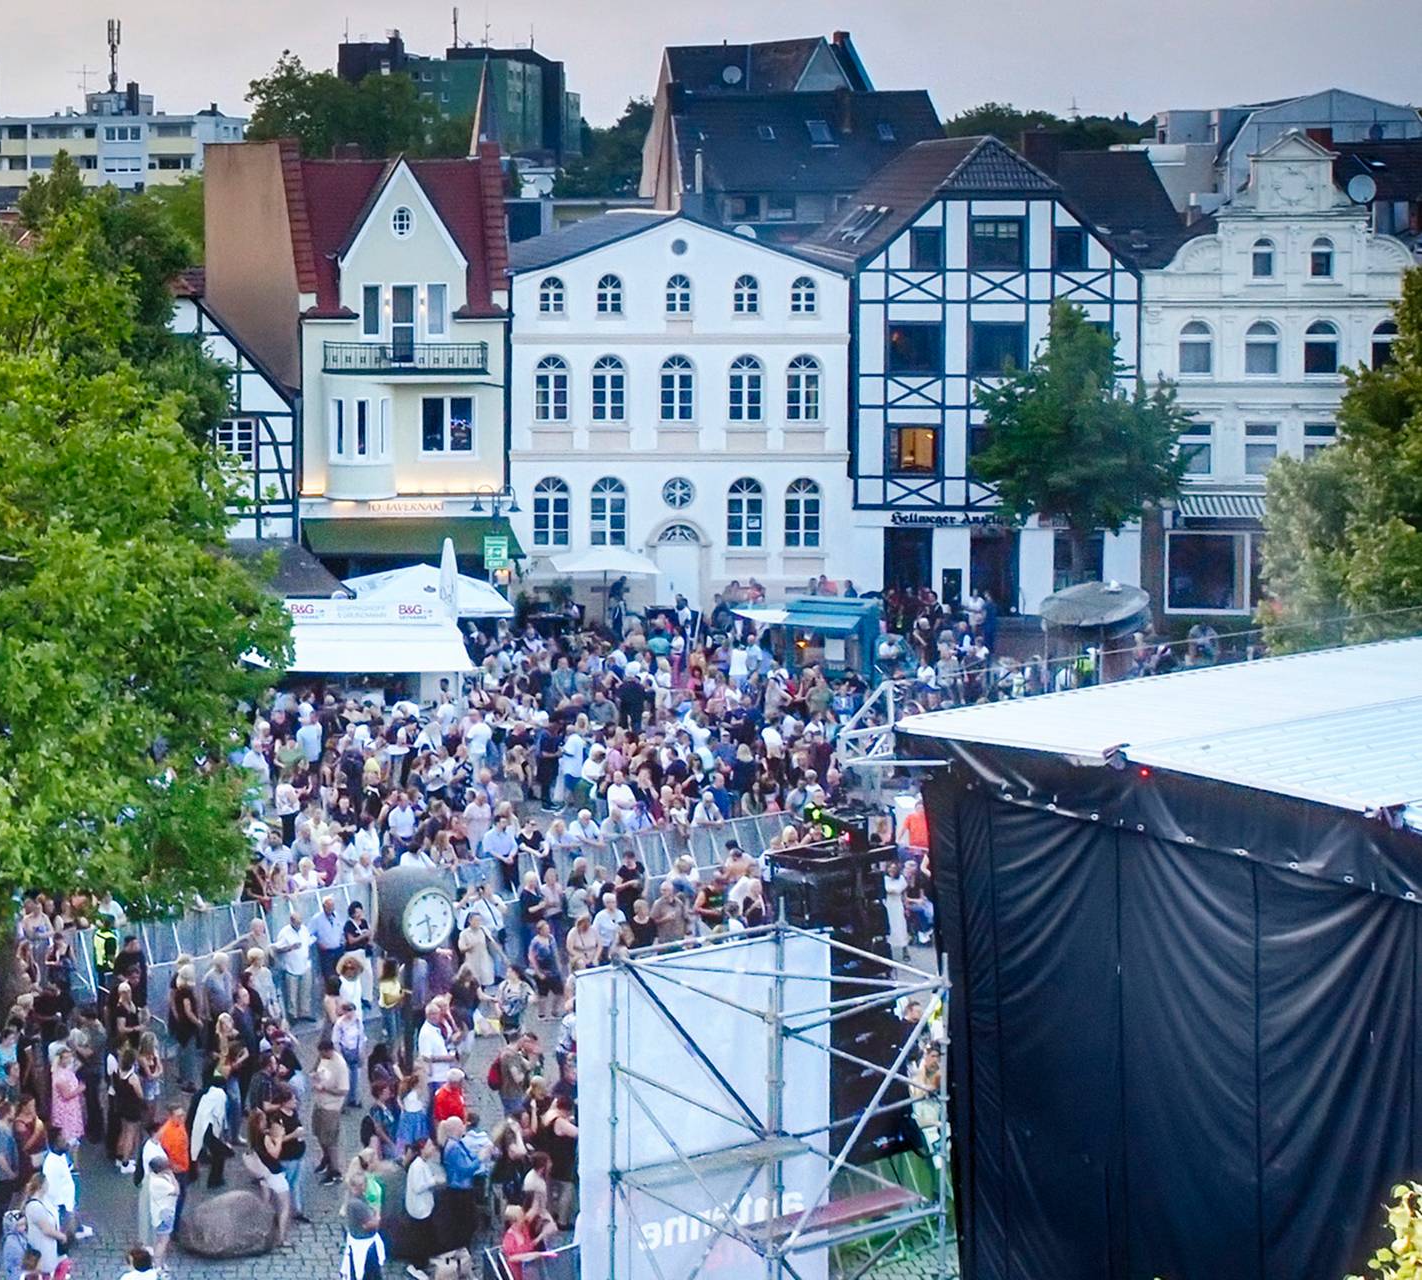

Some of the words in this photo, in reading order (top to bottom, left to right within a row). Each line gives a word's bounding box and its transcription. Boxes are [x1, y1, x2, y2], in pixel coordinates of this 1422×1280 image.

[890, 511, 956, 527] Hellweger
[291, 604, 314, 614] B&G
[398, 604, 422, 614] B&G
